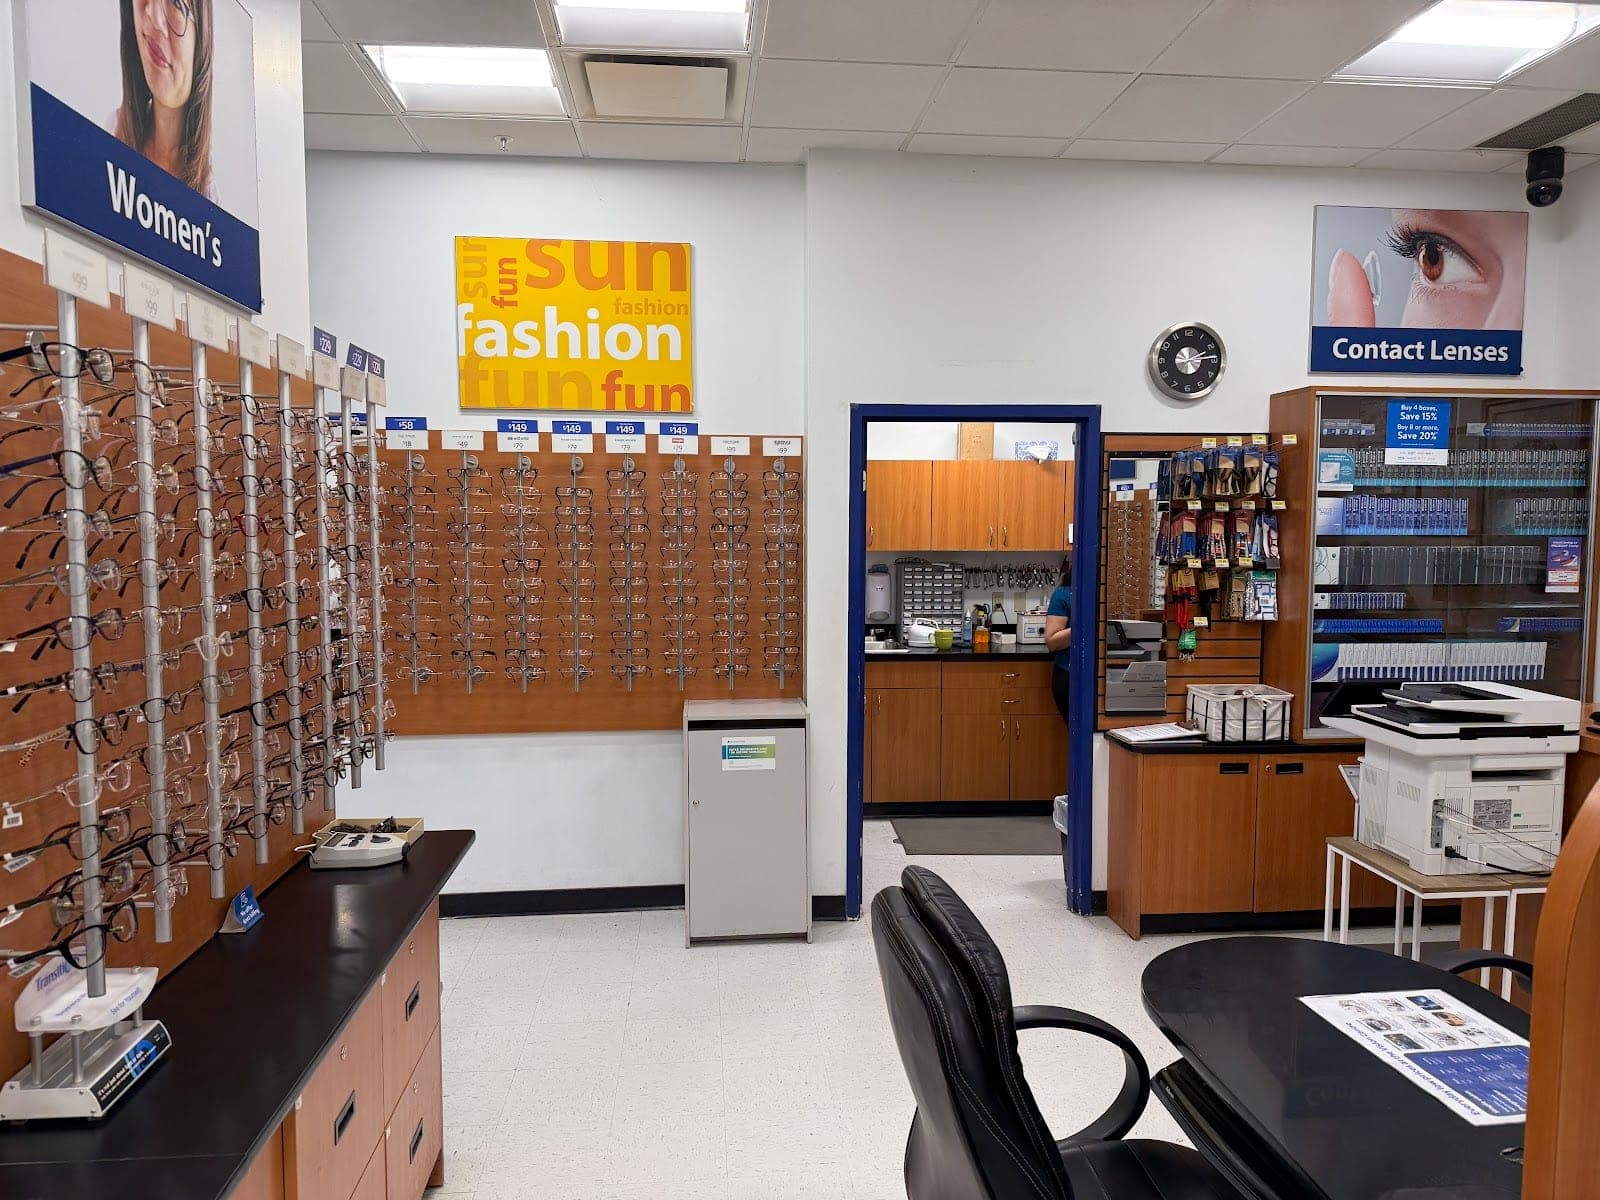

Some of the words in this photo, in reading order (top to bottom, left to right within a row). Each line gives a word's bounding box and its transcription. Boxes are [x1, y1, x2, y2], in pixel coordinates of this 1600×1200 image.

[106, 161, 223, 267] Women's
[525, 239, 687, 292] sun
[491, 257, 518, 309] fun
[614, 297, 689, 316] fashion
[458, 303, 682, 360] fashion
[1184, 329, 1194, 337] 12
[1161, 341, 1171, 352] 10
[1332, 337, 1425, 360] Contact
[1430, 339, 1509, 362] Lenses
[1207, 370, 1215, 378] 4
[460, 352, 593, 408] fun
[1171, 380, 1178, 388] 7
[1197, 380, 1205, 388] 5
[601, 369, 691, 411] fun
[1184, 384, 1191, 392] 6
[1400, 412, 1420, 421] Save
[1422, 412, 1437, 421] 15%
[399, 421, 414, 430] $58
[508, 423, 528, 432] $149
[562, 424, 581, 433] $149
[616, 425, 635, 434] $149
[670, 426, 688, 435] $149
[1398, 431, 1417, 440] Save
